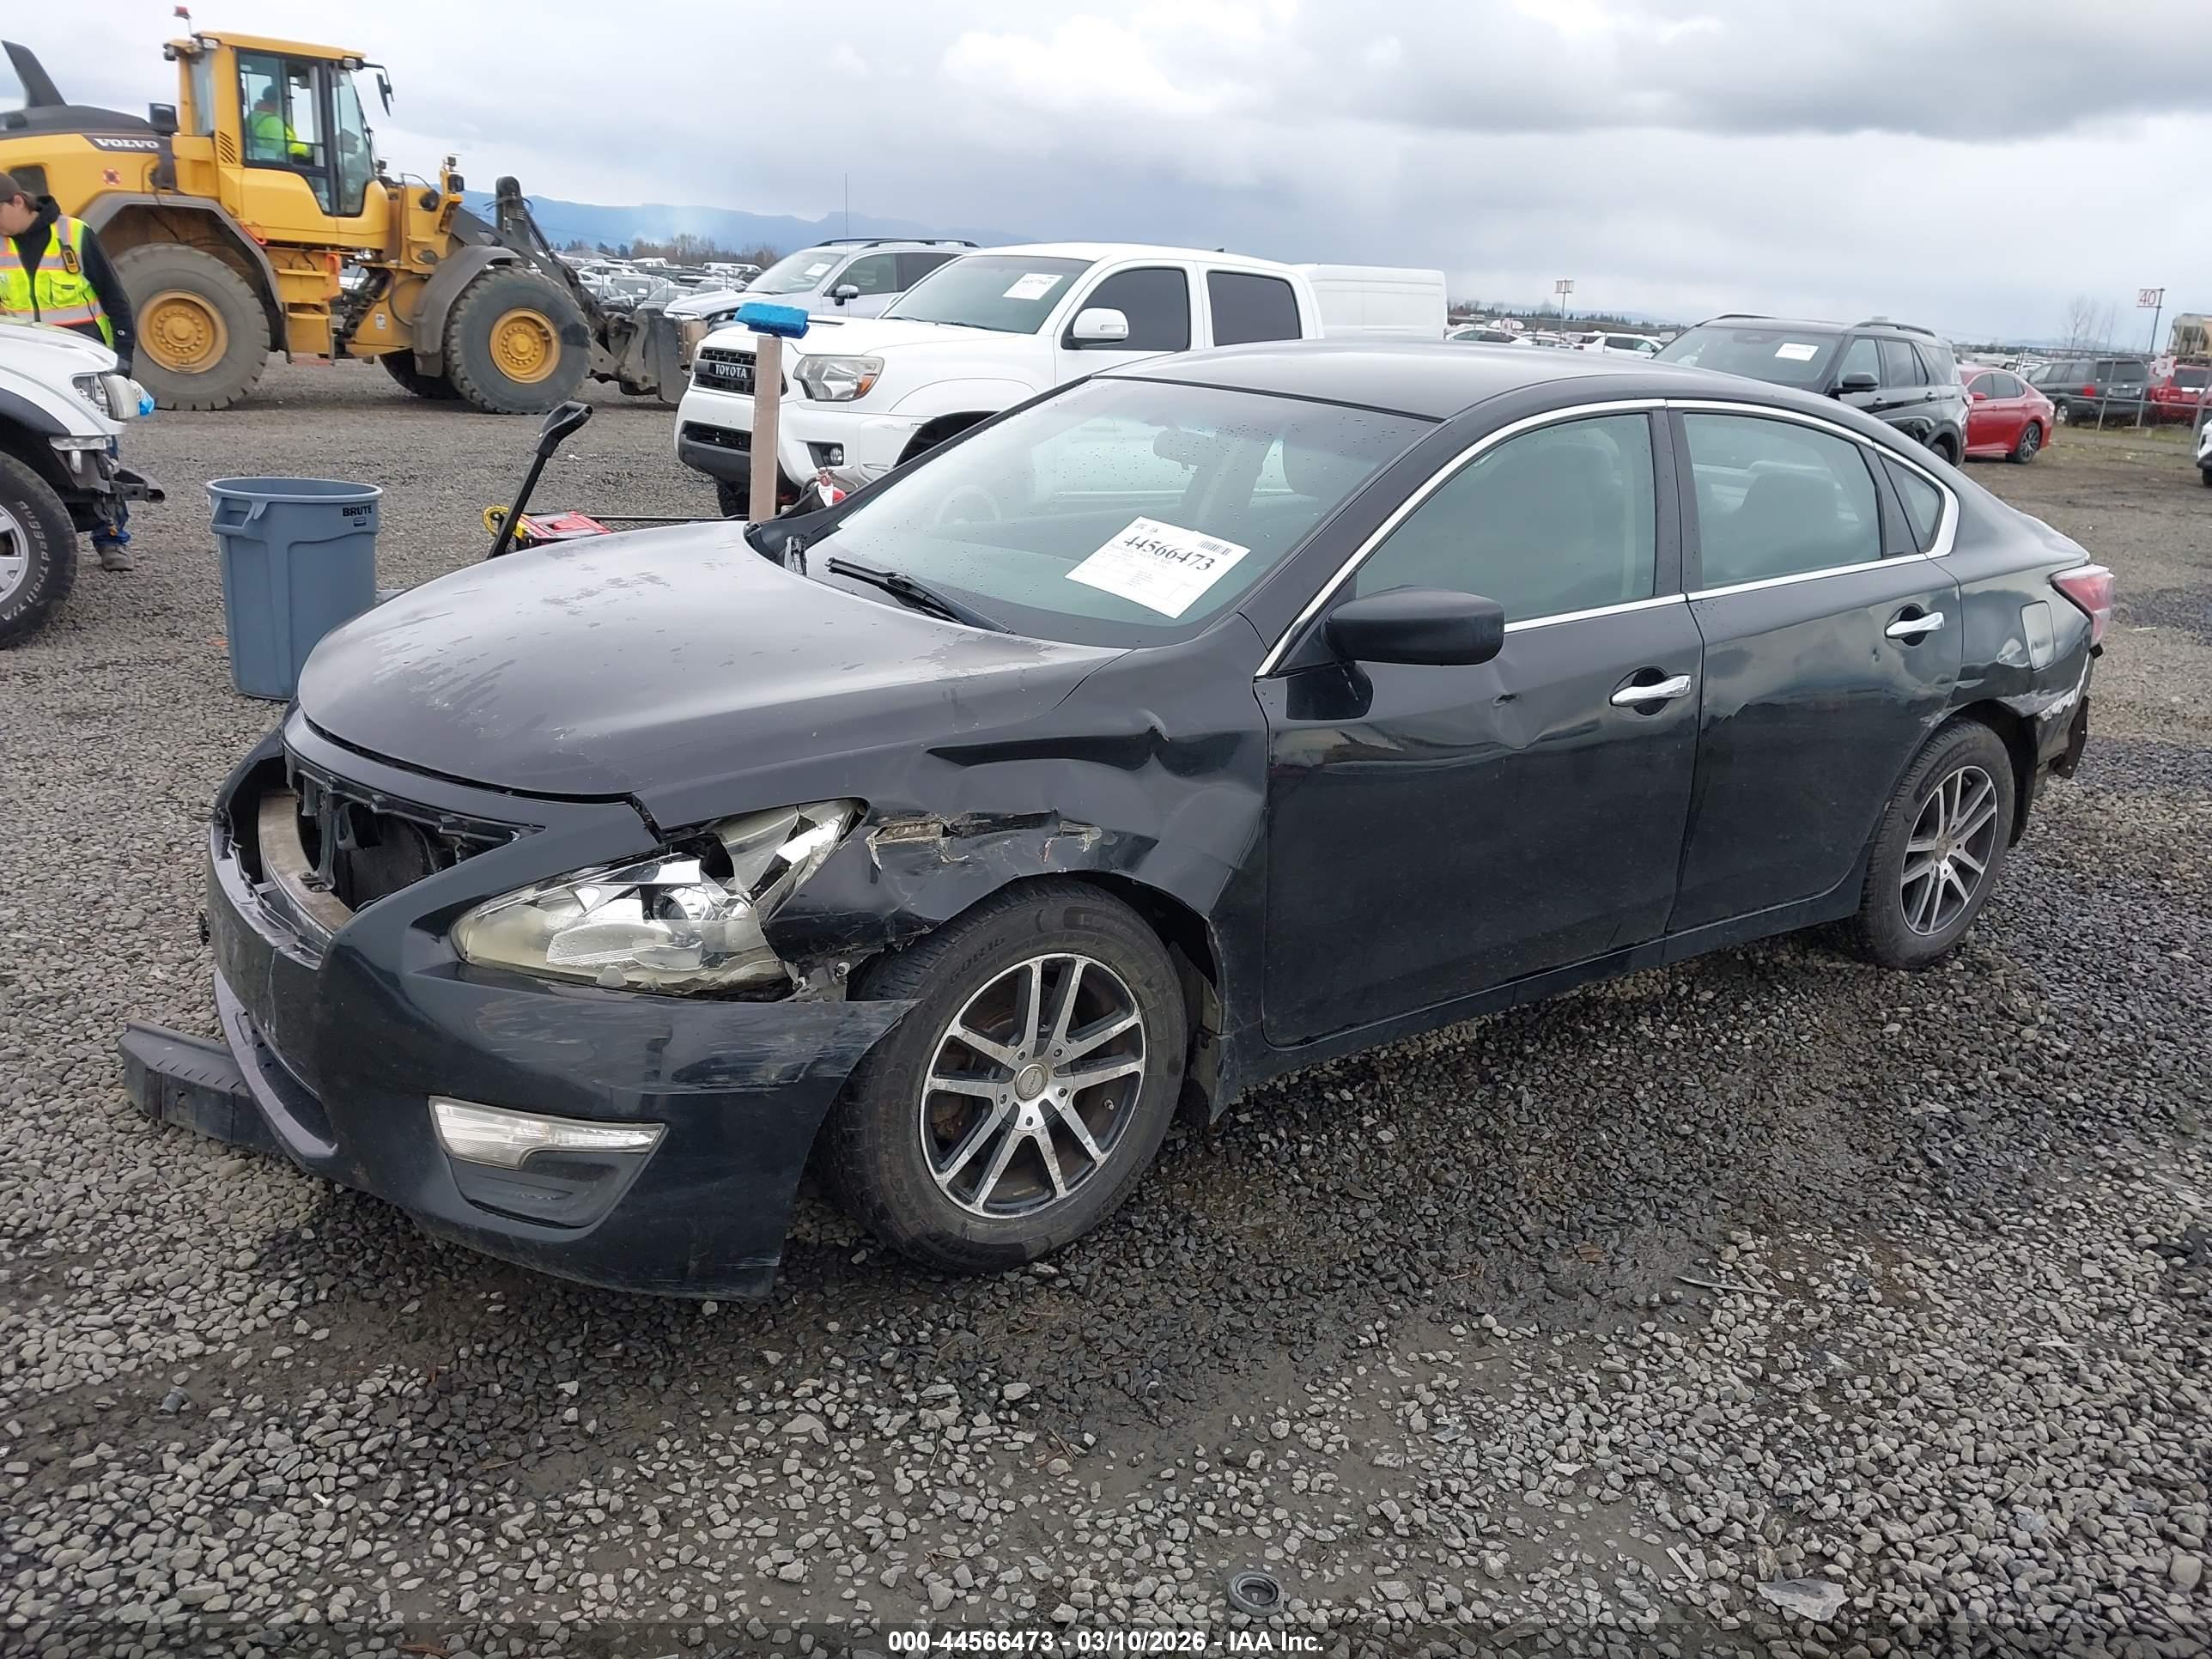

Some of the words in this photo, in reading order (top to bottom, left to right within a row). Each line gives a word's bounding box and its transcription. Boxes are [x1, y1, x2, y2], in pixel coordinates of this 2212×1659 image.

[93, 138, 160, 149] VOLVO
[2139, 290, 2157, 306] 40
[715, 363, 747, 378] TOYOTA
[342, 505, 372, 517] BRUTE
[1123, 535, 1216, 571] 44566473
[26, 565, 49, 603] Trail
